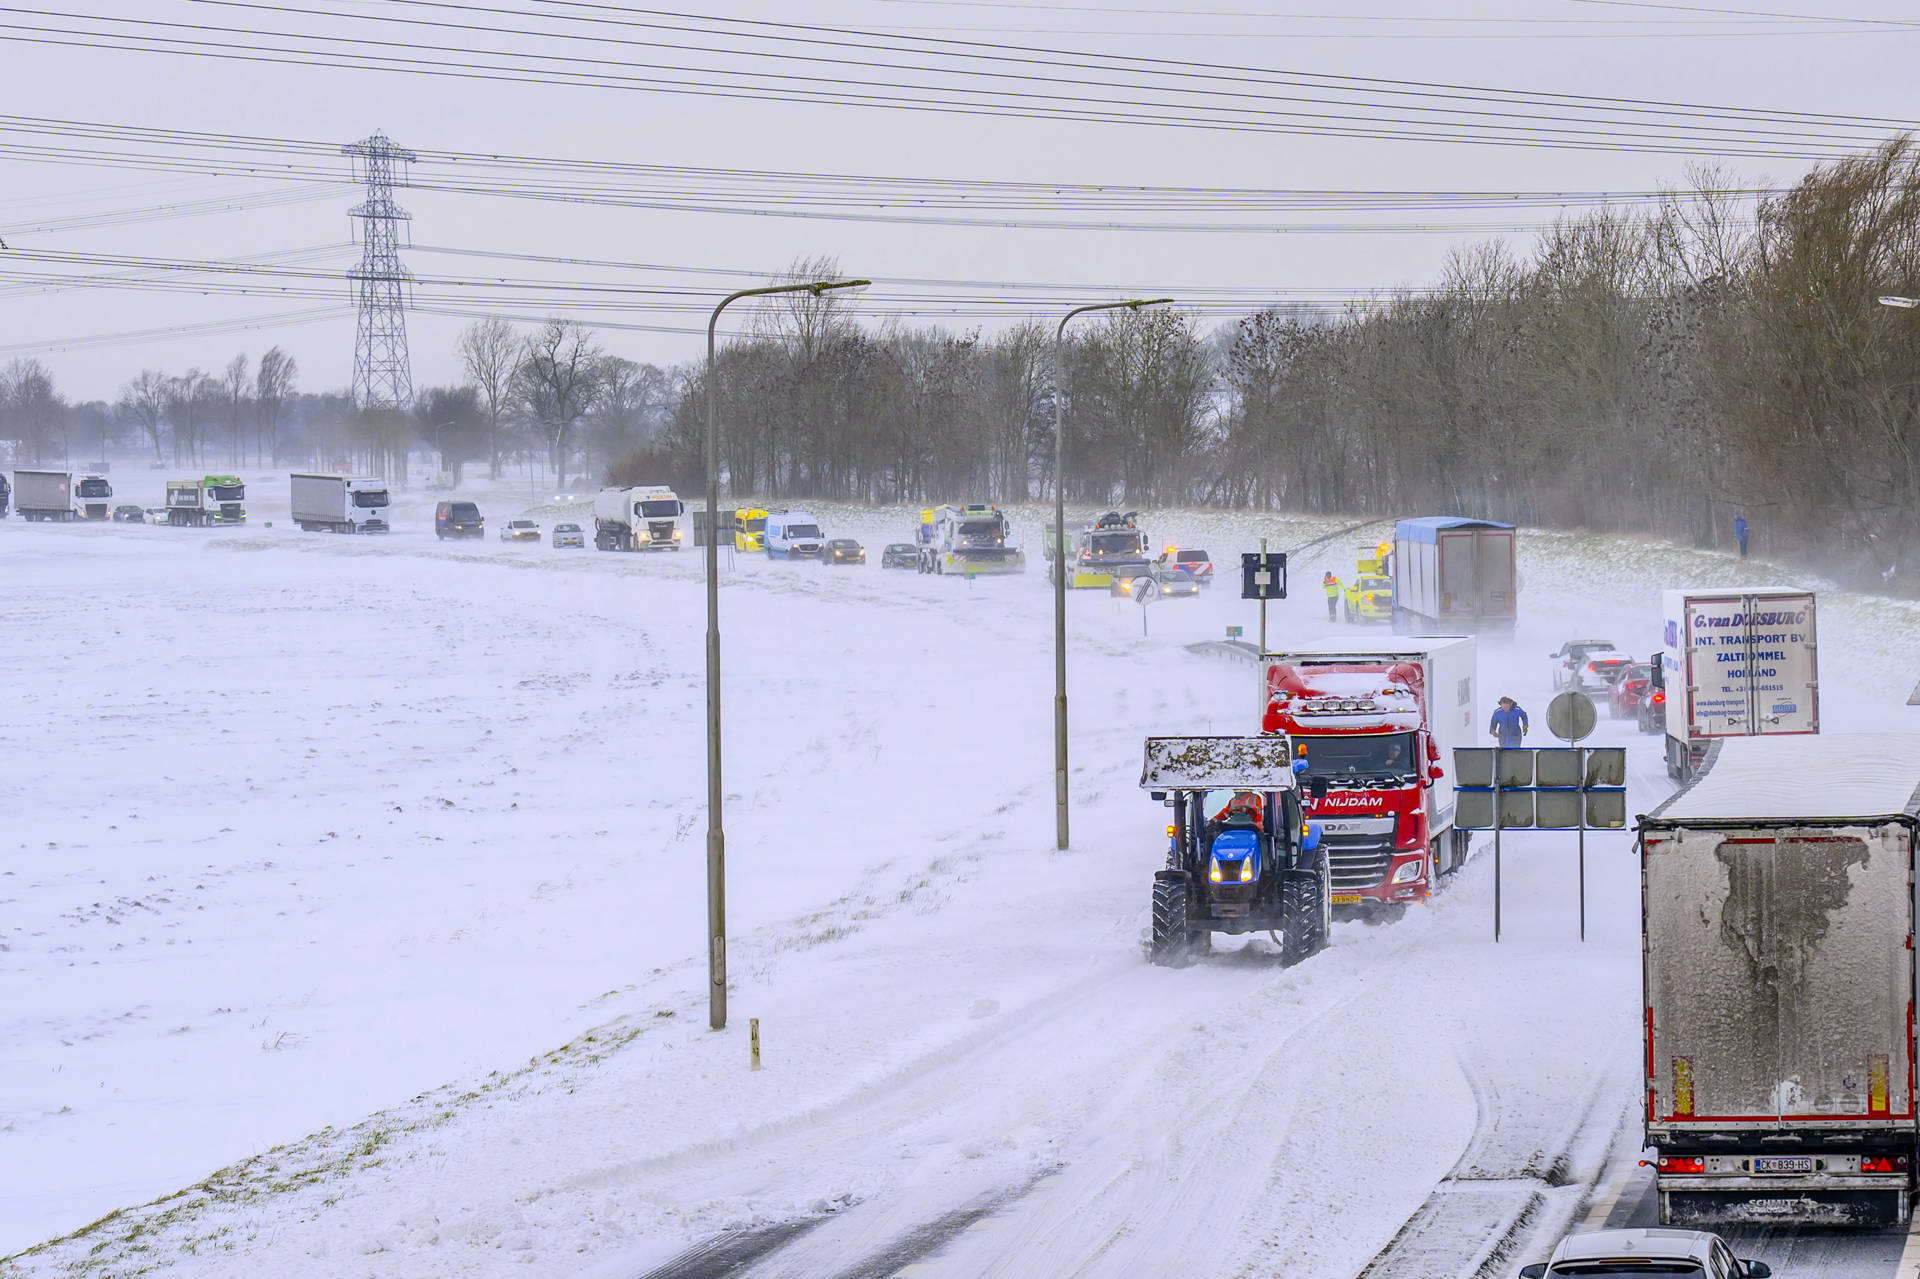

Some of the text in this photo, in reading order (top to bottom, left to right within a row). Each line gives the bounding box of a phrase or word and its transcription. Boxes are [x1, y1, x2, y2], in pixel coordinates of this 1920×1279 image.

[1695, 633, 1806, 646] INT. TRANSPORT BV
[1716, 651, 1786, 662] ZALTBOMMEL
[1727, 668, 1776, 678] HOLLAND
[1324, 797, 1383, 807] NIJDAM
[1324, 823, 1361, 831] DAF
[1761, 1160, 1772, 1170] CK
